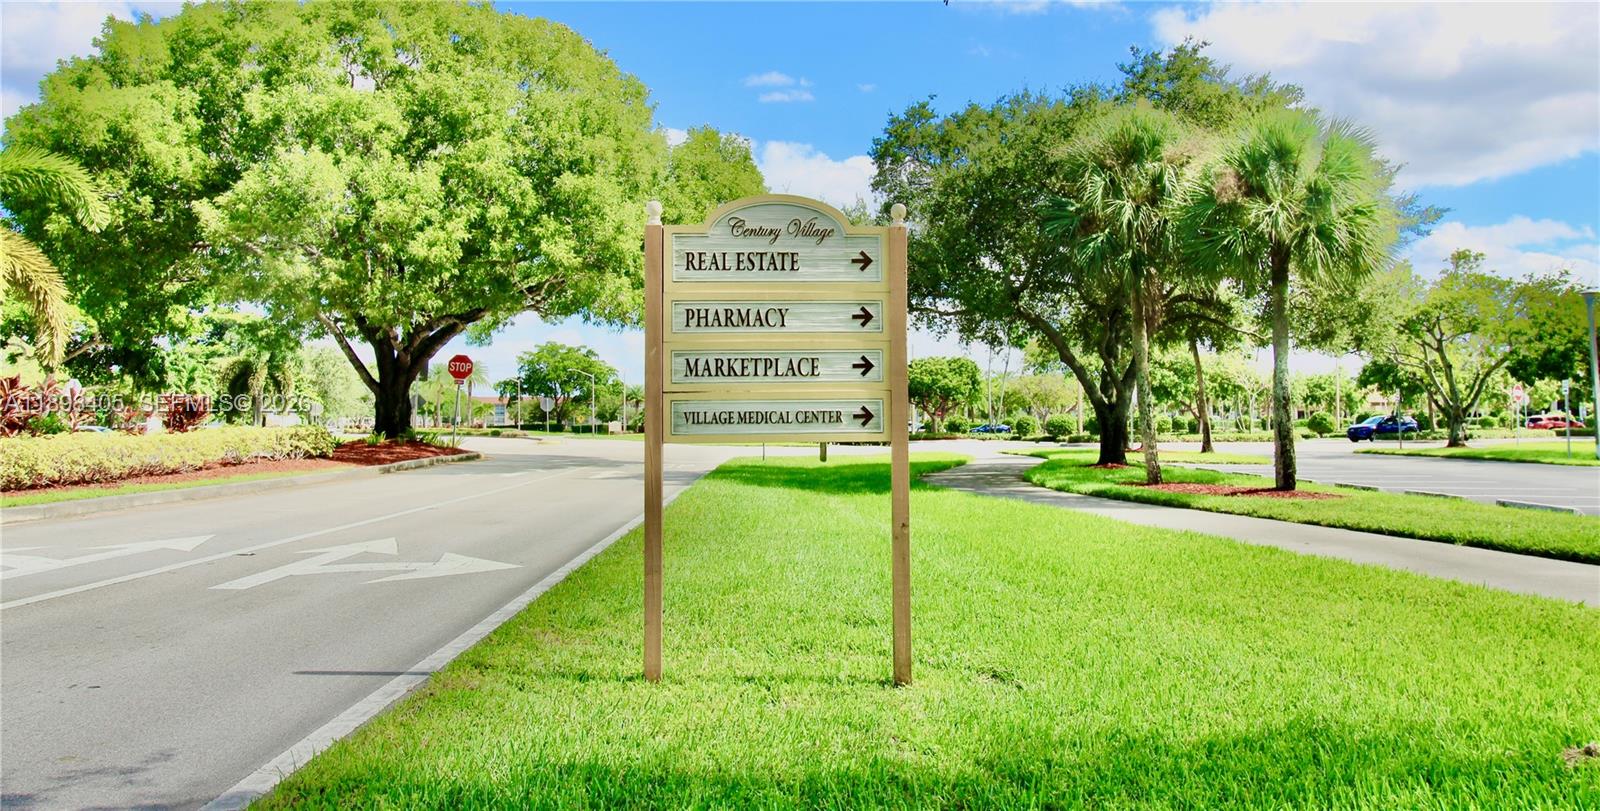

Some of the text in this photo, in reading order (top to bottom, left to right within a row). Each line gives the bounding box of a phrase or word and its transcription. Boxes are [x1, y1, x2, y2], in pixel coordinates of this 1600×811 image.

[728, 217, 835, 245] Century Village
[685, 252, 800, 270] REAL ESTATE
[684, 308, 789, 328] PHARMACY
[450, 362, 472, 372] STOP
[684, 357, 821, 377] MARKETPLACE
[683, 410, 843, 425] VILLAGE MEDICAL CENTER
